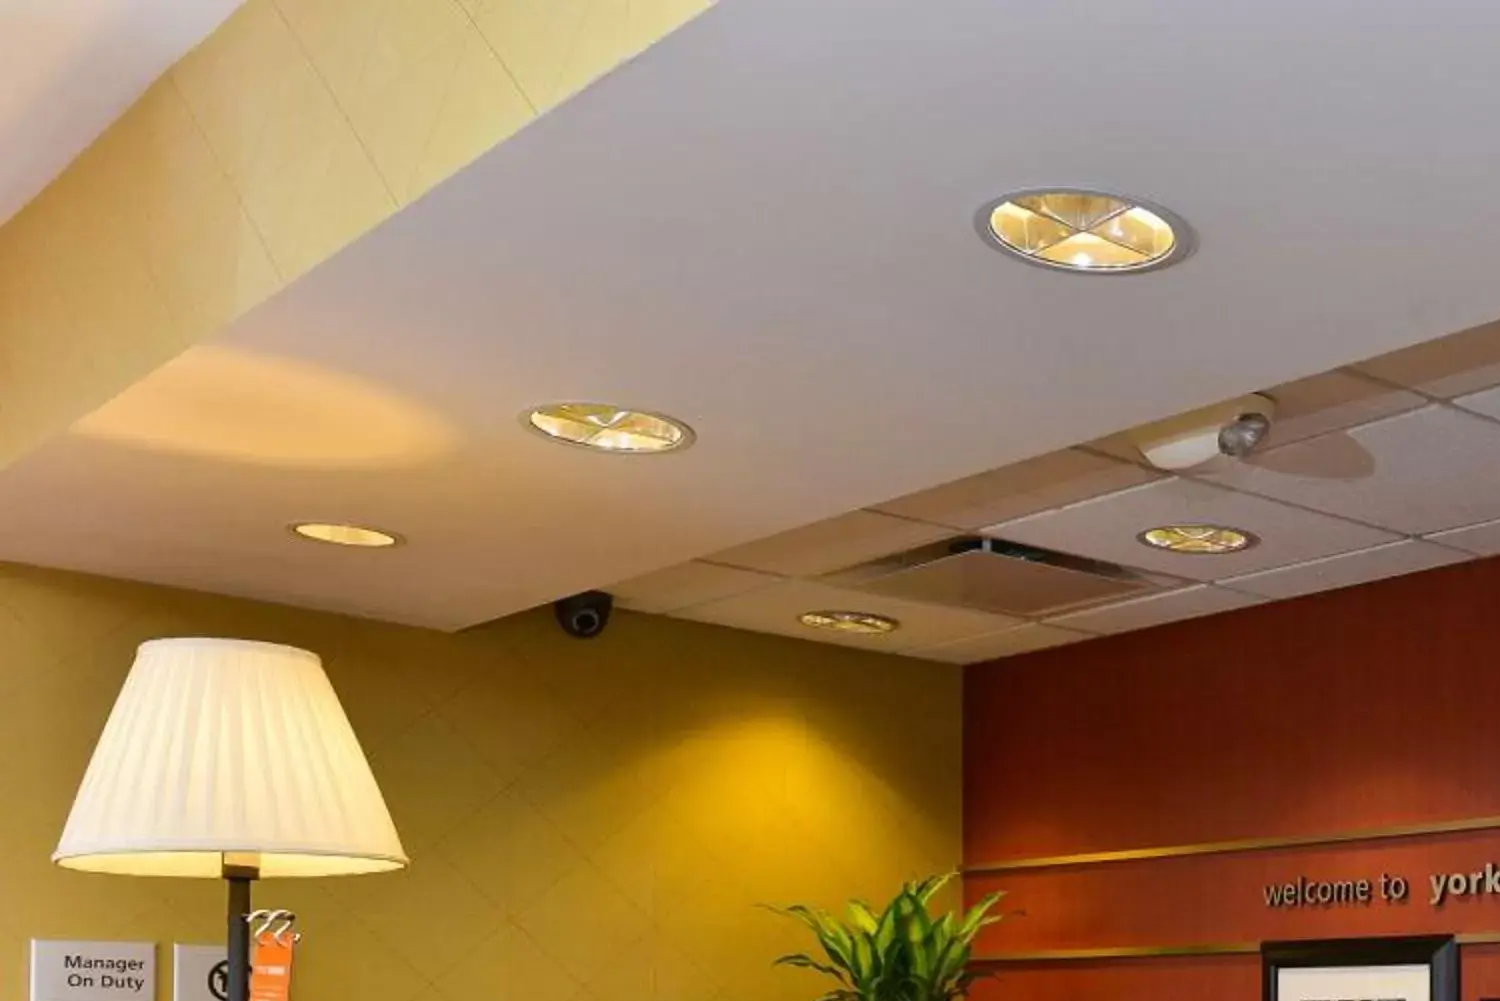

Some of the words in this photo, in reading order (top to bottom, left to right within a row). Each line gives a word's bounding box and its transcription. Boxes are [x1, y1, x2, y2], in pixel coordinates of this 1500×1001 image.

[1263, 877, 1370, 906] welcome
[1380, 873, 1408, 900] to
[63, 955, 145, 973] Manager
[67, 974, 94, 988] On
[100, 975, 145, 992] Duty
